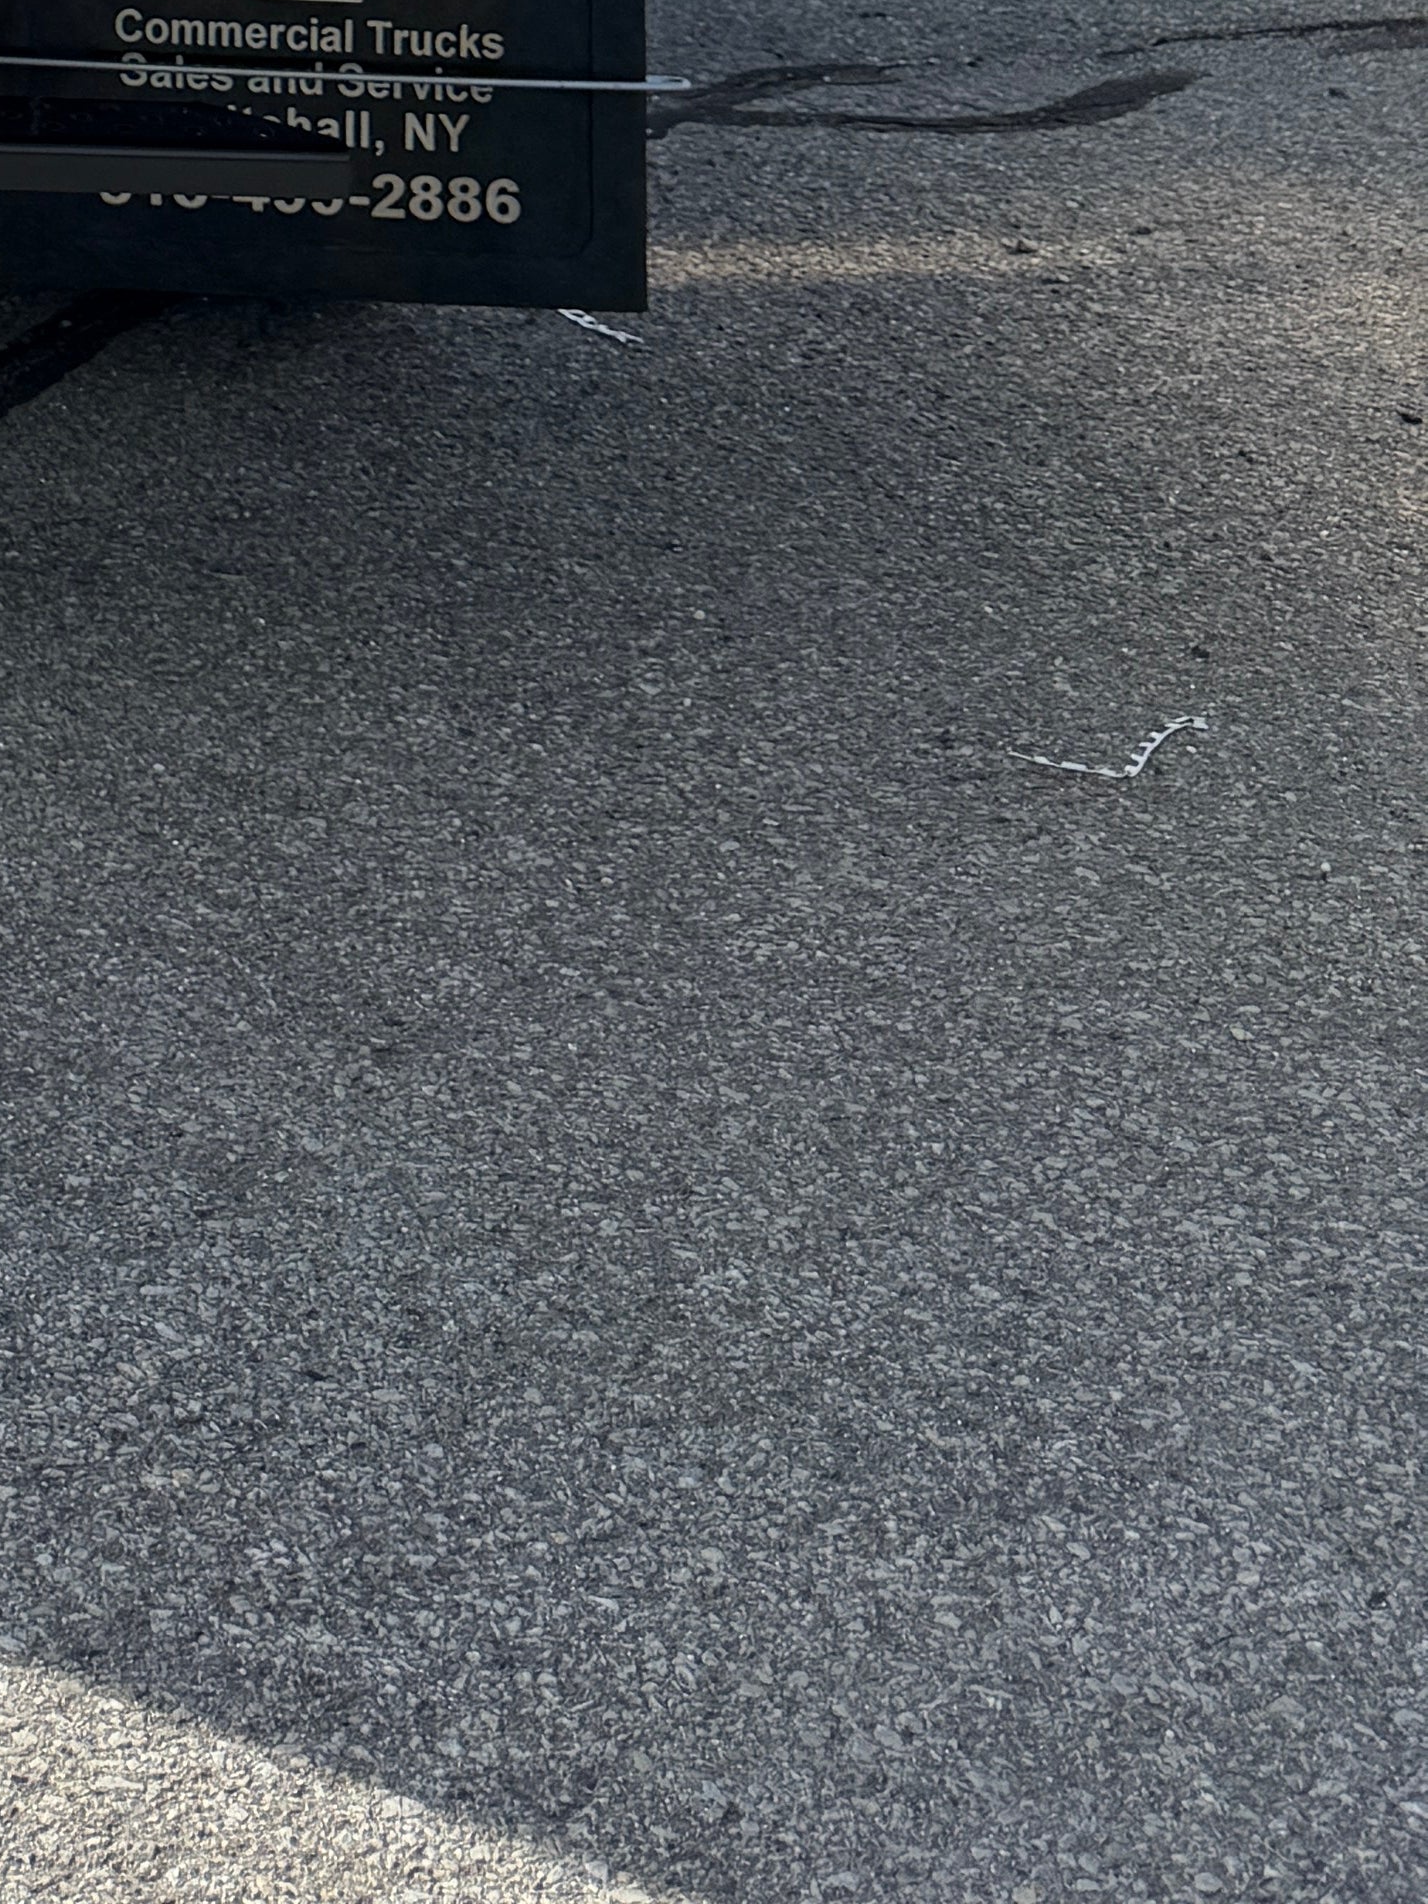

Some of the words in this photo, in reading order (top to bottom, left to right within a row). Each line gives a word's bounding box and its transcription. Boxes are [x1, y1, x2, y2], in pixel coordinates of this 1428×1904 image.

[114, 8, 354, 53] Commercial
[367, 20, 505, 60] Trucks
[404, 113, 471, 153] NY
